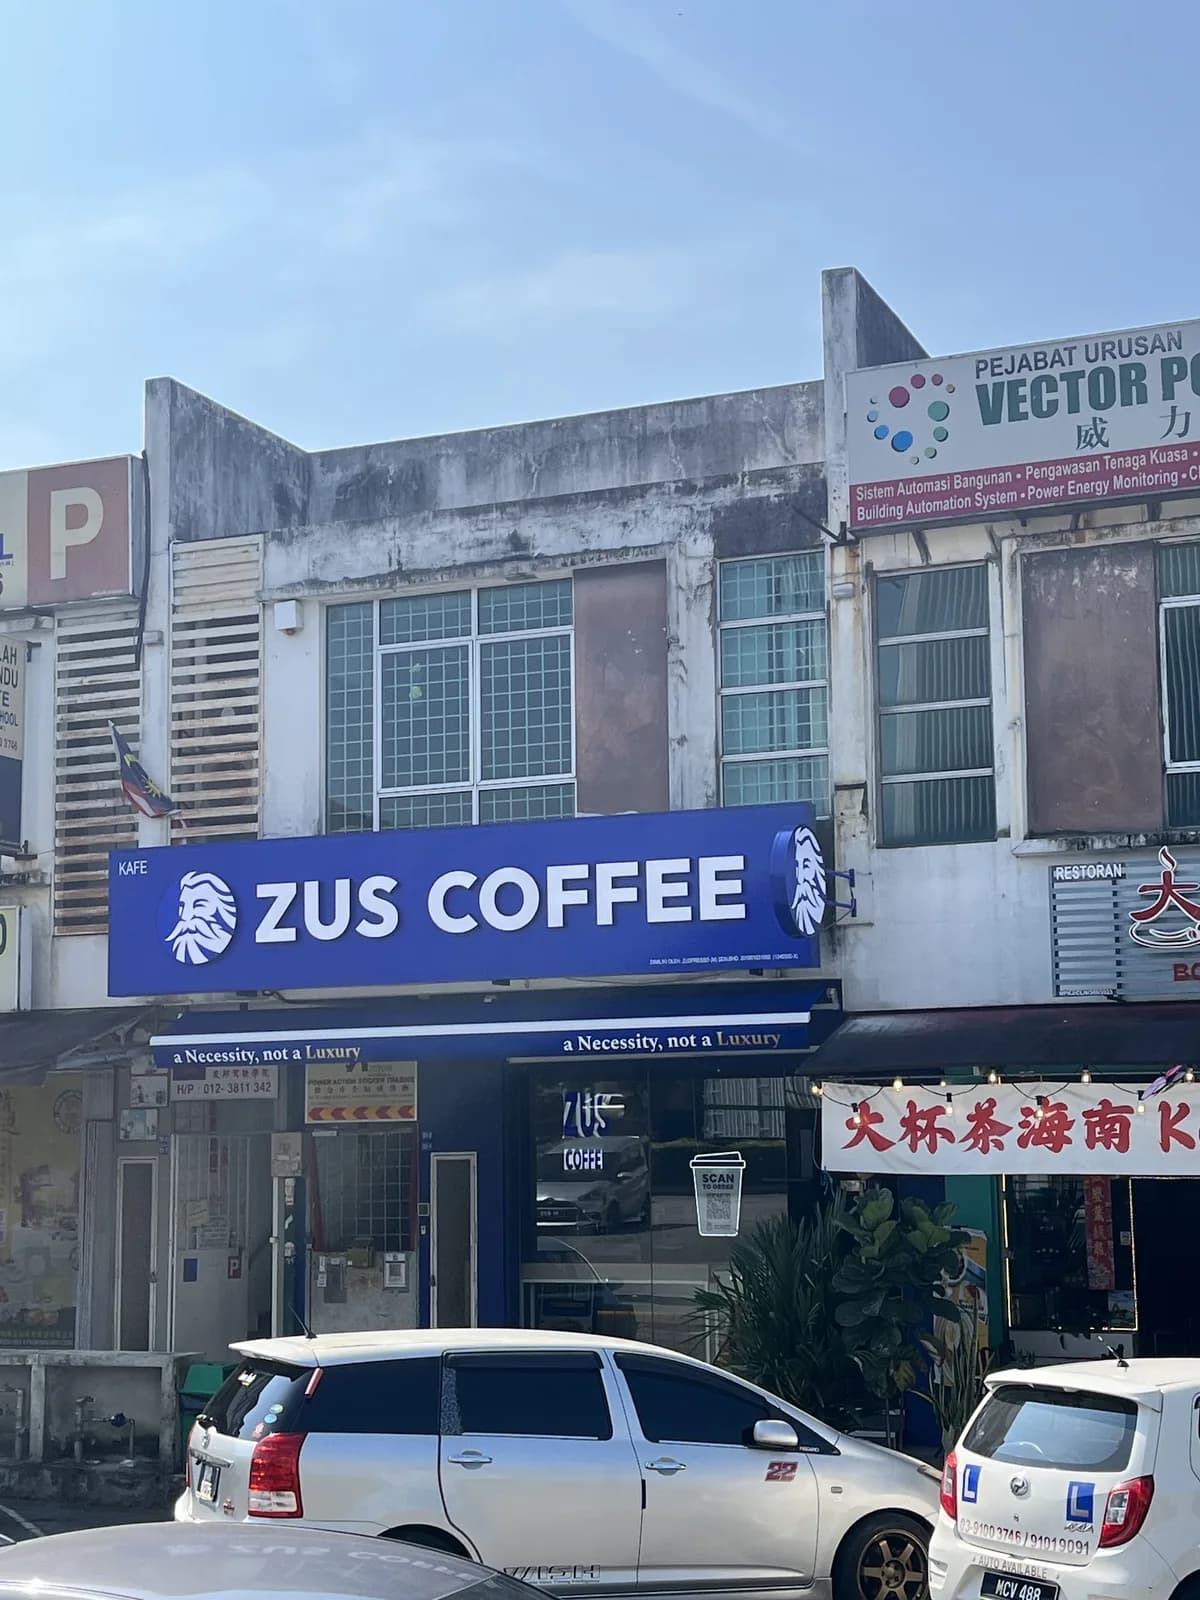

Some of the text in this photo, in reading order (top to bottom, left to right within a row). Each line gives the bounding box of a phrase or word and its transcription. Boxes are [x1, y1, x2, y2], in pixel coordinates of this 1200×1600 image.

[975, 331, 1183, 379] PEJABAT URUSAN
[975, 362, 1149, 426] VECTOR
[1075, 405, 1191, 450] 威 力
[856, 449, 1189, 501] Sistem Automasi Bangunan Pengawasan Tenaga Kuasa
[856, 502, 903, 521] Building
[905, 493, 972, 514] Automation
[974, 489, 1018, 510] System
[1027, 483, 1063, 501] Power
[1067, 478, 1110, 498] Energy
[1112, 469, 1179, 491] Monitoring
[49, 487, 104, 581] P
[0, 644, 17, 666] AH
[118, 860, 148, 876] KAFE
[1055, 863, 1122, 880] RESTORAN
[255, 855, 746, 943] ZUS COFFEE
[173, 1044, 361, 1065] a Necessity, not a Luxury
[563, 1030, 781, 1053] a Necessity, not a Luxury
[841, 1095, 1200, 1154] 大杯茶海南 K
[702, 1173, 735, 1184] SCAN
[765, 1461, 799, 1482] 22
[964, 1468, 977, 1499] L
[1070, 1485, 1089, 1518] L
[1002, 1559, 1048, 1580] AVAILABLE
